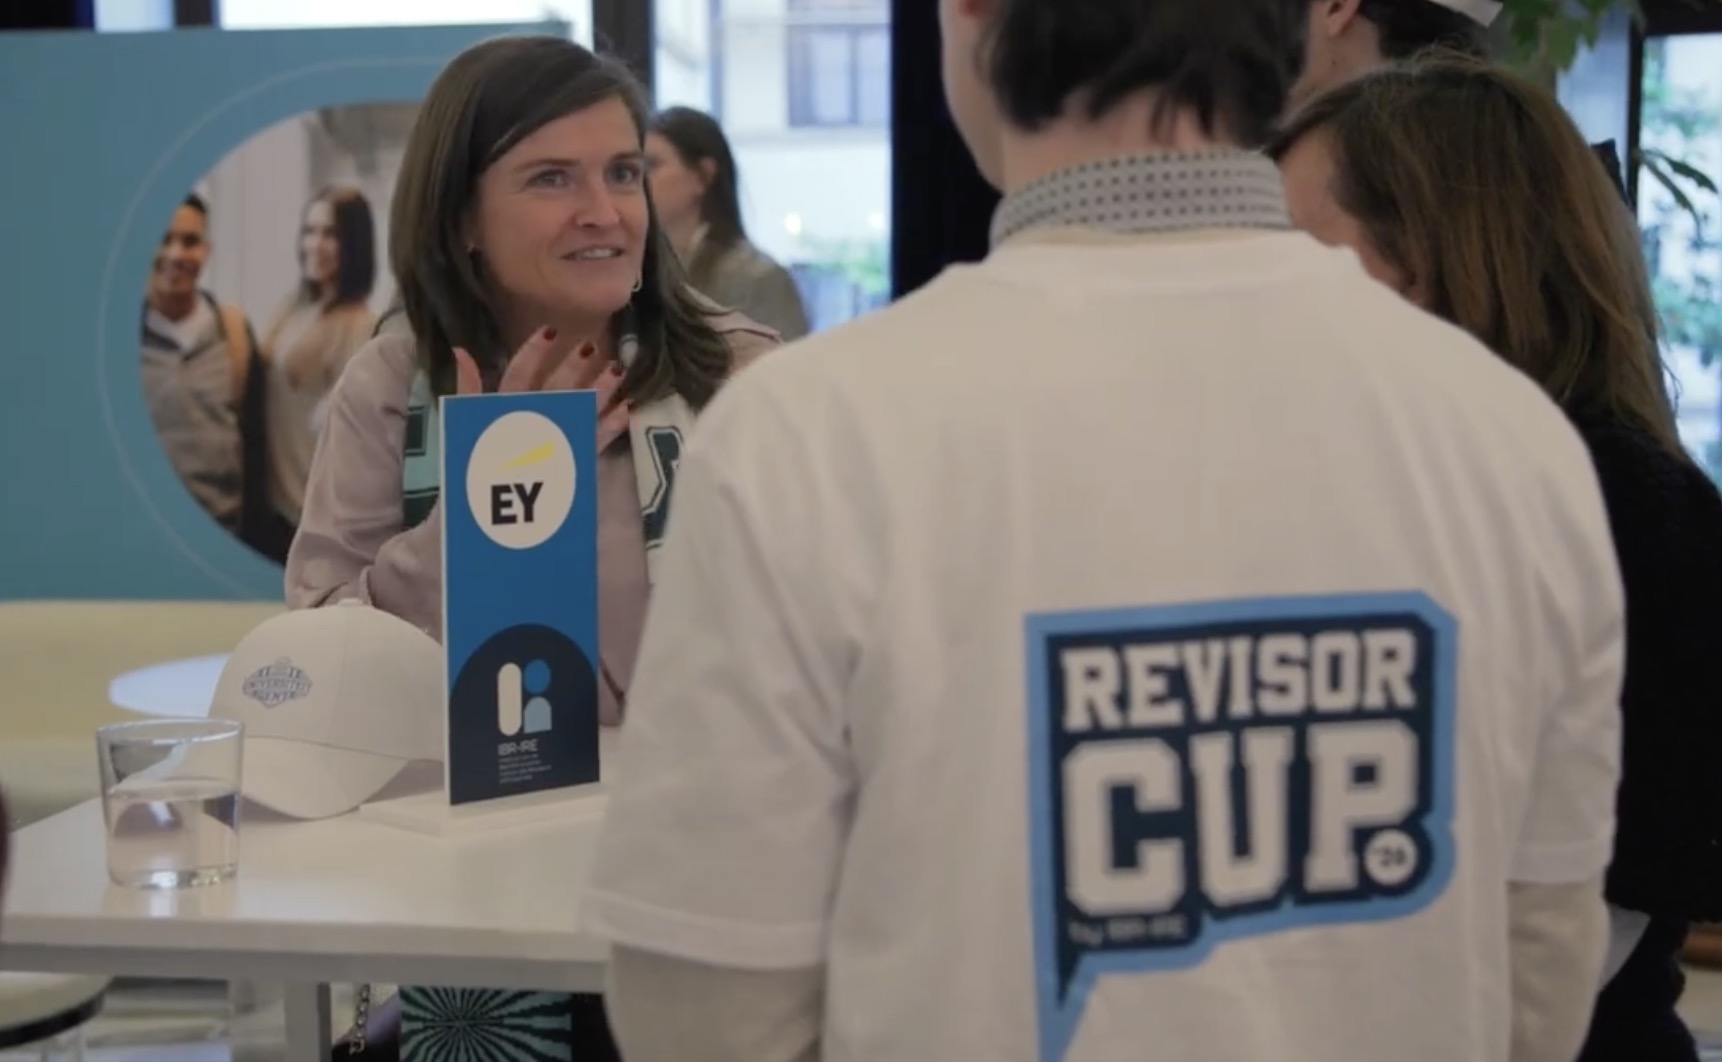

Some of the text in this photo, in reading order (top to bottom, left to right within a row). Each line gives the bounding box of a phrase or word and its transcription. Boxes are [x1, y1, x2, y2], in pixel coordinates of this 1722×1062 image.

[490, 482, 544, 525] EY
[1060, 628, 1417, 732] REVISOR
[1061, 718, 1419, 918] CUP
